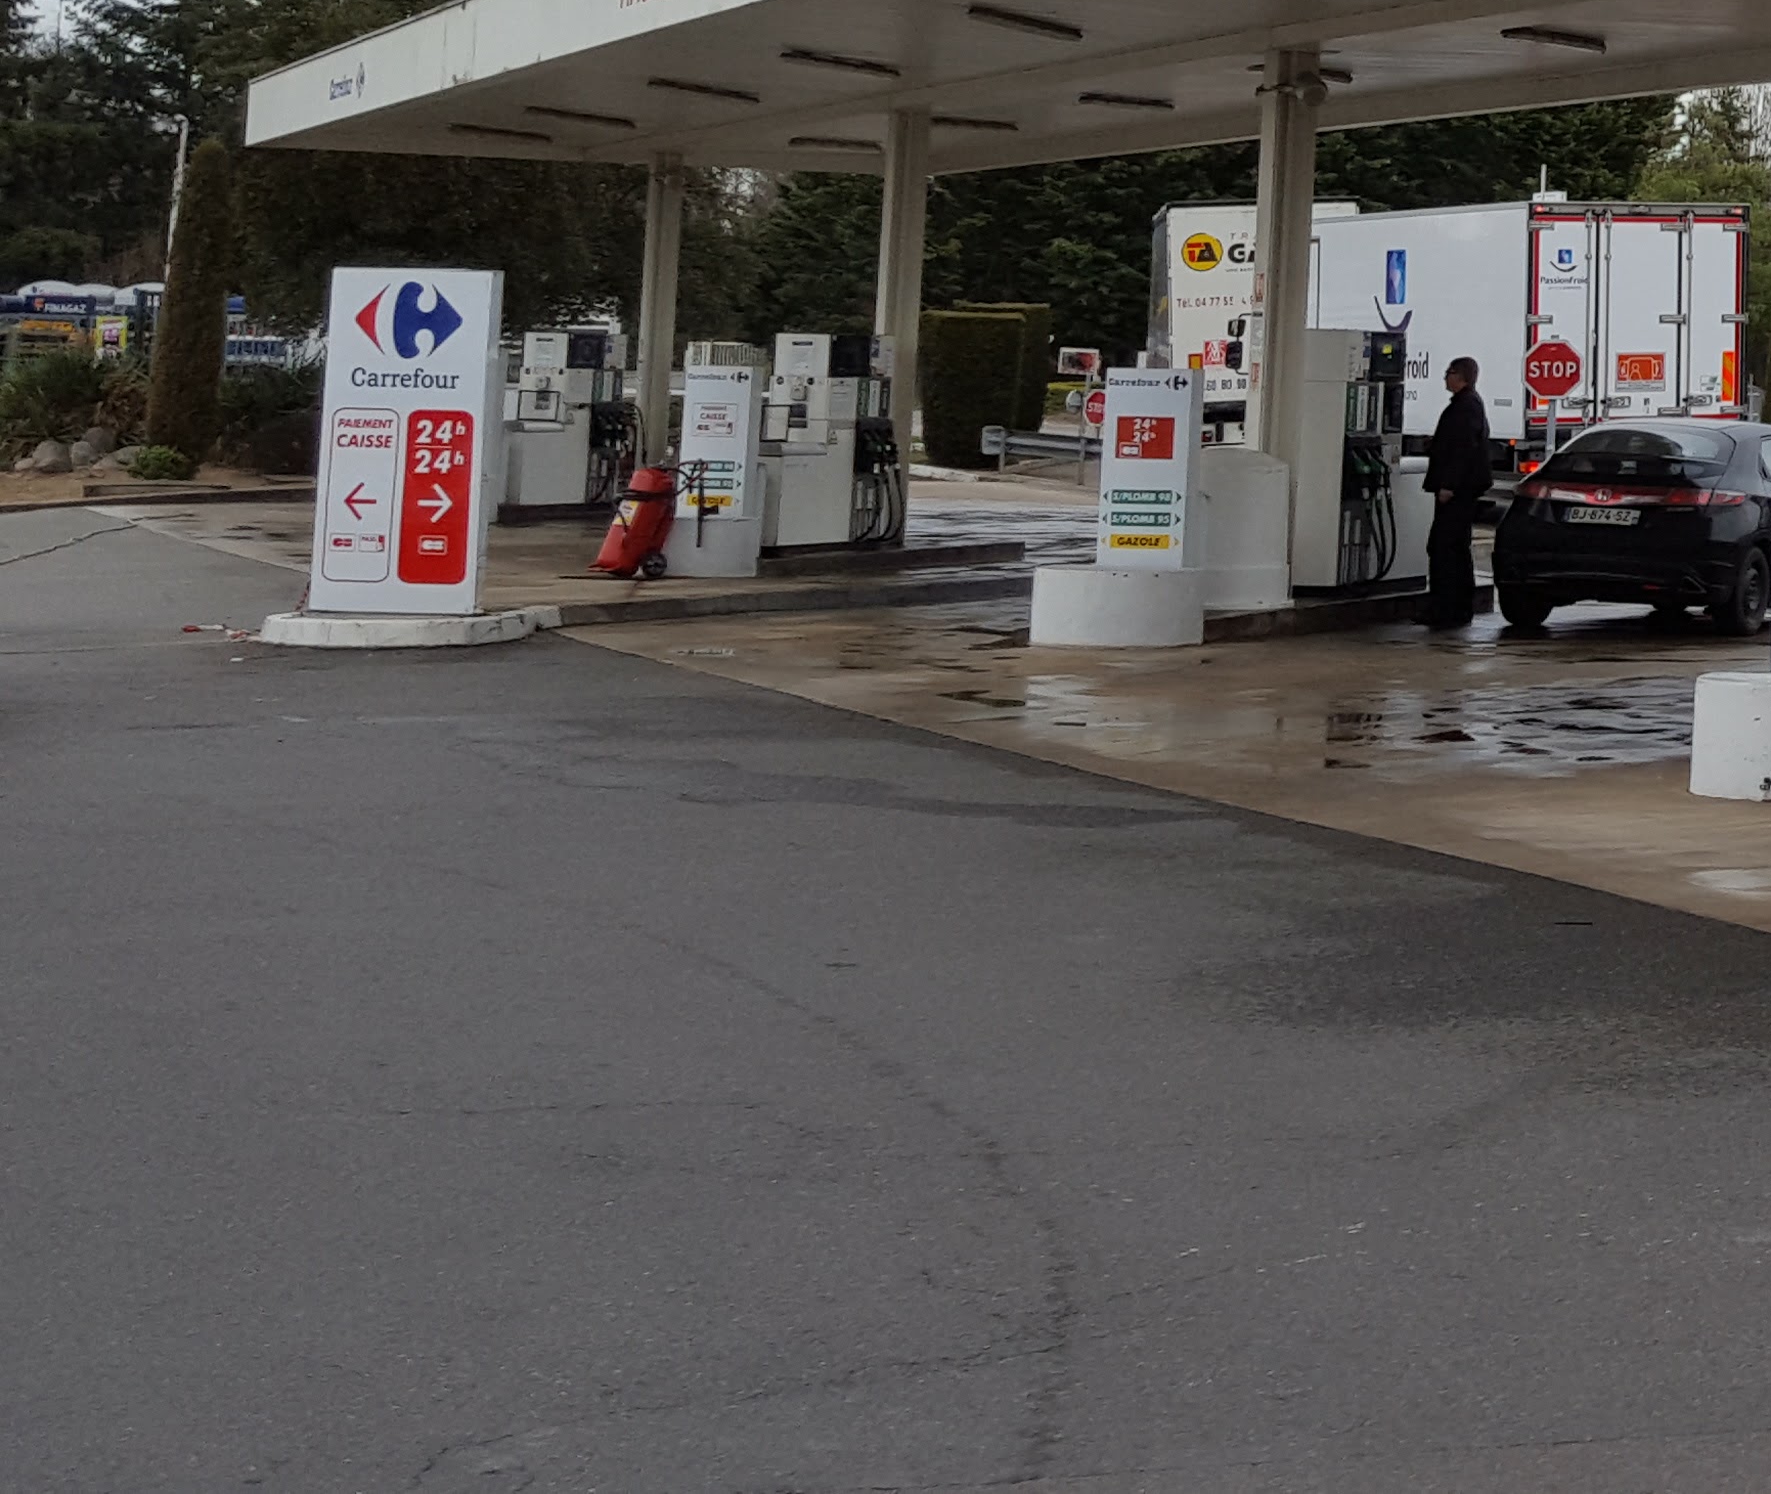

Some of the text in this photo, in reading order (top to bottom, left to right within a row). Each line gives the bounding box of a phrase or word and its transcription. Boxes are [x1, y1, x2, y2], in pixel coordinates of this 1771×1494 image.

[1528, 361, 1577, 378] STOP
[351, 367, 459, 389] Carrefour
[1108, 377, 1161, 387] Carrefour
[337, 418, 393, 429] PAIEMENT
[415, 419, 466, 445] 24h
[337, 434, 393, 448] CAISSE
[414, 448, 465, 474] 24h
[1111, 490, 1156, 502] S/PLOMB
[1111, 512, 1155, 525] S/PLOMB
[1116, 536, 1161, 547] GAZOLE
